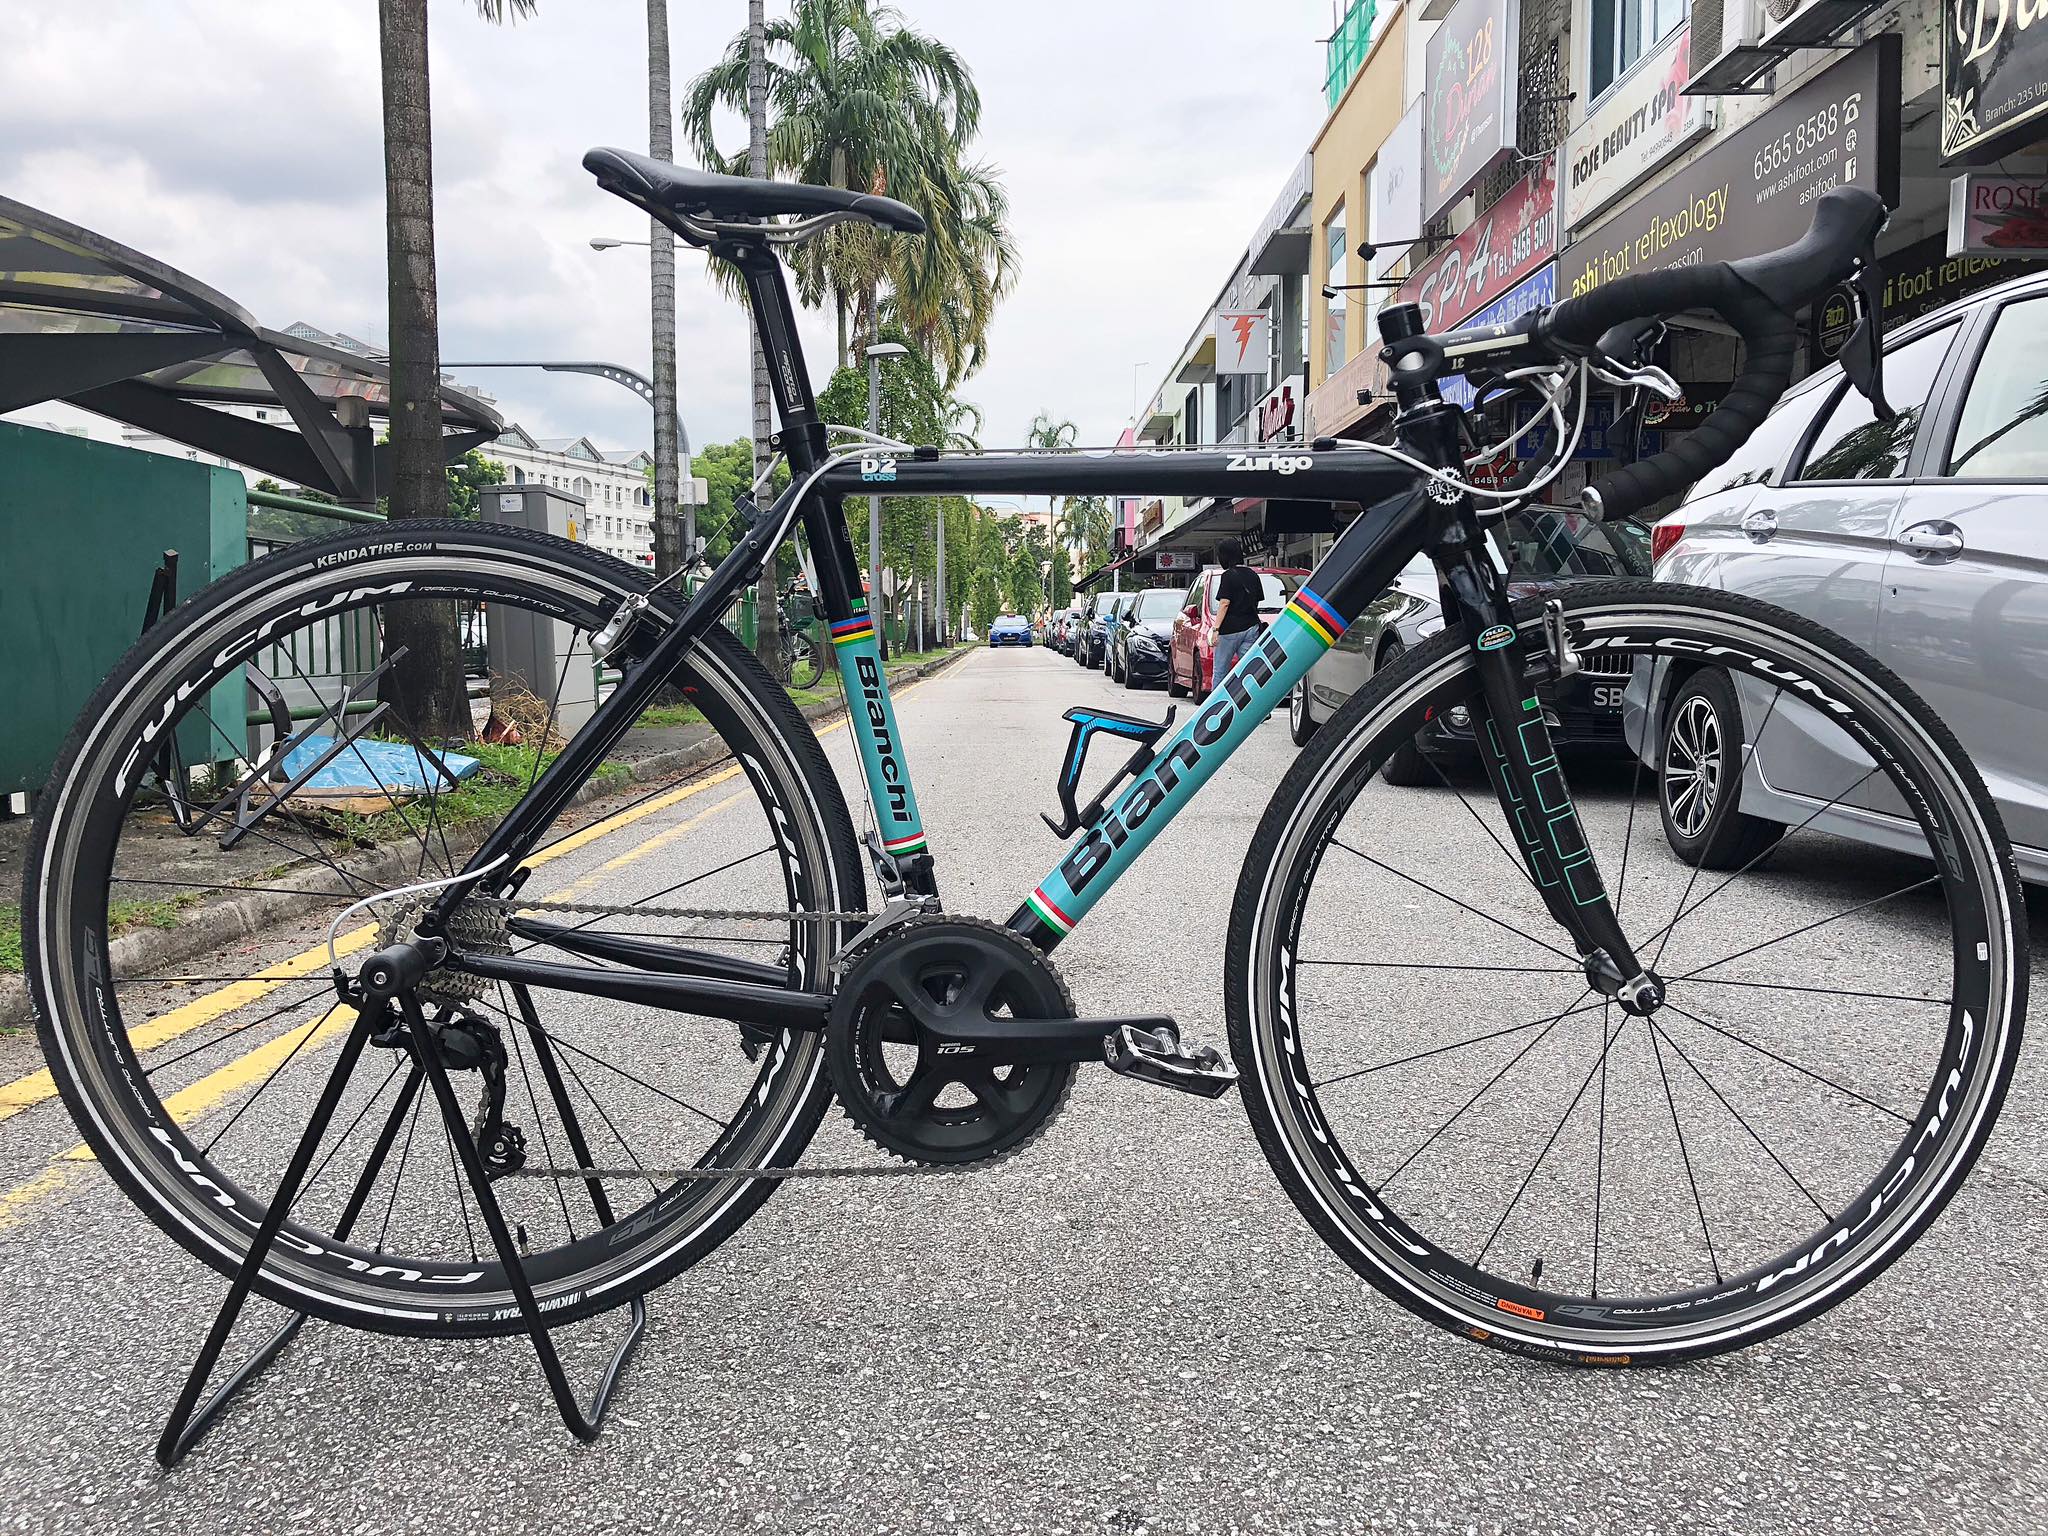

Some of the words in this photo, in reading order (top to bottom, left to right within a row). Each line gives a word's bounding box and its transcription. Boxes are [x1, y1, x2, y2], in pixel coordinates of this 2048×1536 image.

[1466, 16, 1493, 87] 128
[1985, 97, 2016, 122] Branch:
[2017, 86, 2033, 106] 235
[1572, 144, 1600, 190] ROSE
[1602, 102, 1649, 165] BEAUTY
[1650, 81, 1676, 126] SPA
[1754, 131, 1791, 181] 6565
[1795, 103, 1838, 155] 8588
[1756, 147, 1838, 204] www.ashifoot.com
[1799, 172, 1838, 206] ashifoot
[1572, 257, 1600, 298] ashi
[1602, 241, 1631, 285] foot
[1635, 183, 1729, 265] reflexology
[1418, 217, 1493, 333] SPA
[1897, 266, 1934, 302] foot
[861, 472, 897, 482] cross
[1226, 453, 1313, 475] Zurigo
[317, 541, 432, 568] KENDATIRE.COM
[115, 580, 413, 799] FULCRUM
[418, 584, 479, 595] RACING
[483, 588, 565, 614] QUATTRO
[855, 656, 912, 822] Bianchi
[1570, 636, 1854, 715] ULCRUM
[1849, 719, 1892, 759] RACING
[1893, 761, 1939, 828] QUATTRO
[1059, 630, 1288, 897] Bianchi
[1303, 811, 1339, 885] QUATTRO
[1288, 886, 1305, 942] RACING
[95, 986, 125, 1072] QUATTRO
[937, 1045, 976, 1055] 105
[120, 1072, 155, 1120] RACING
[1279, 945, 1430, 1256] FULCRUM
[719, 1106, 753, 1155] RACING
[1756, 1009, 1974, 1292] FULCRUM
[1500, 1301, 1533, 1316] WARNING
[1613, 1302, 1691, 1315] QUATTRO
[1694, 1283, 1750, 1307] RACING
[1492, 1336, 1520, 1351] Plus
[1524, 1344, 1572, 1362] Touring
